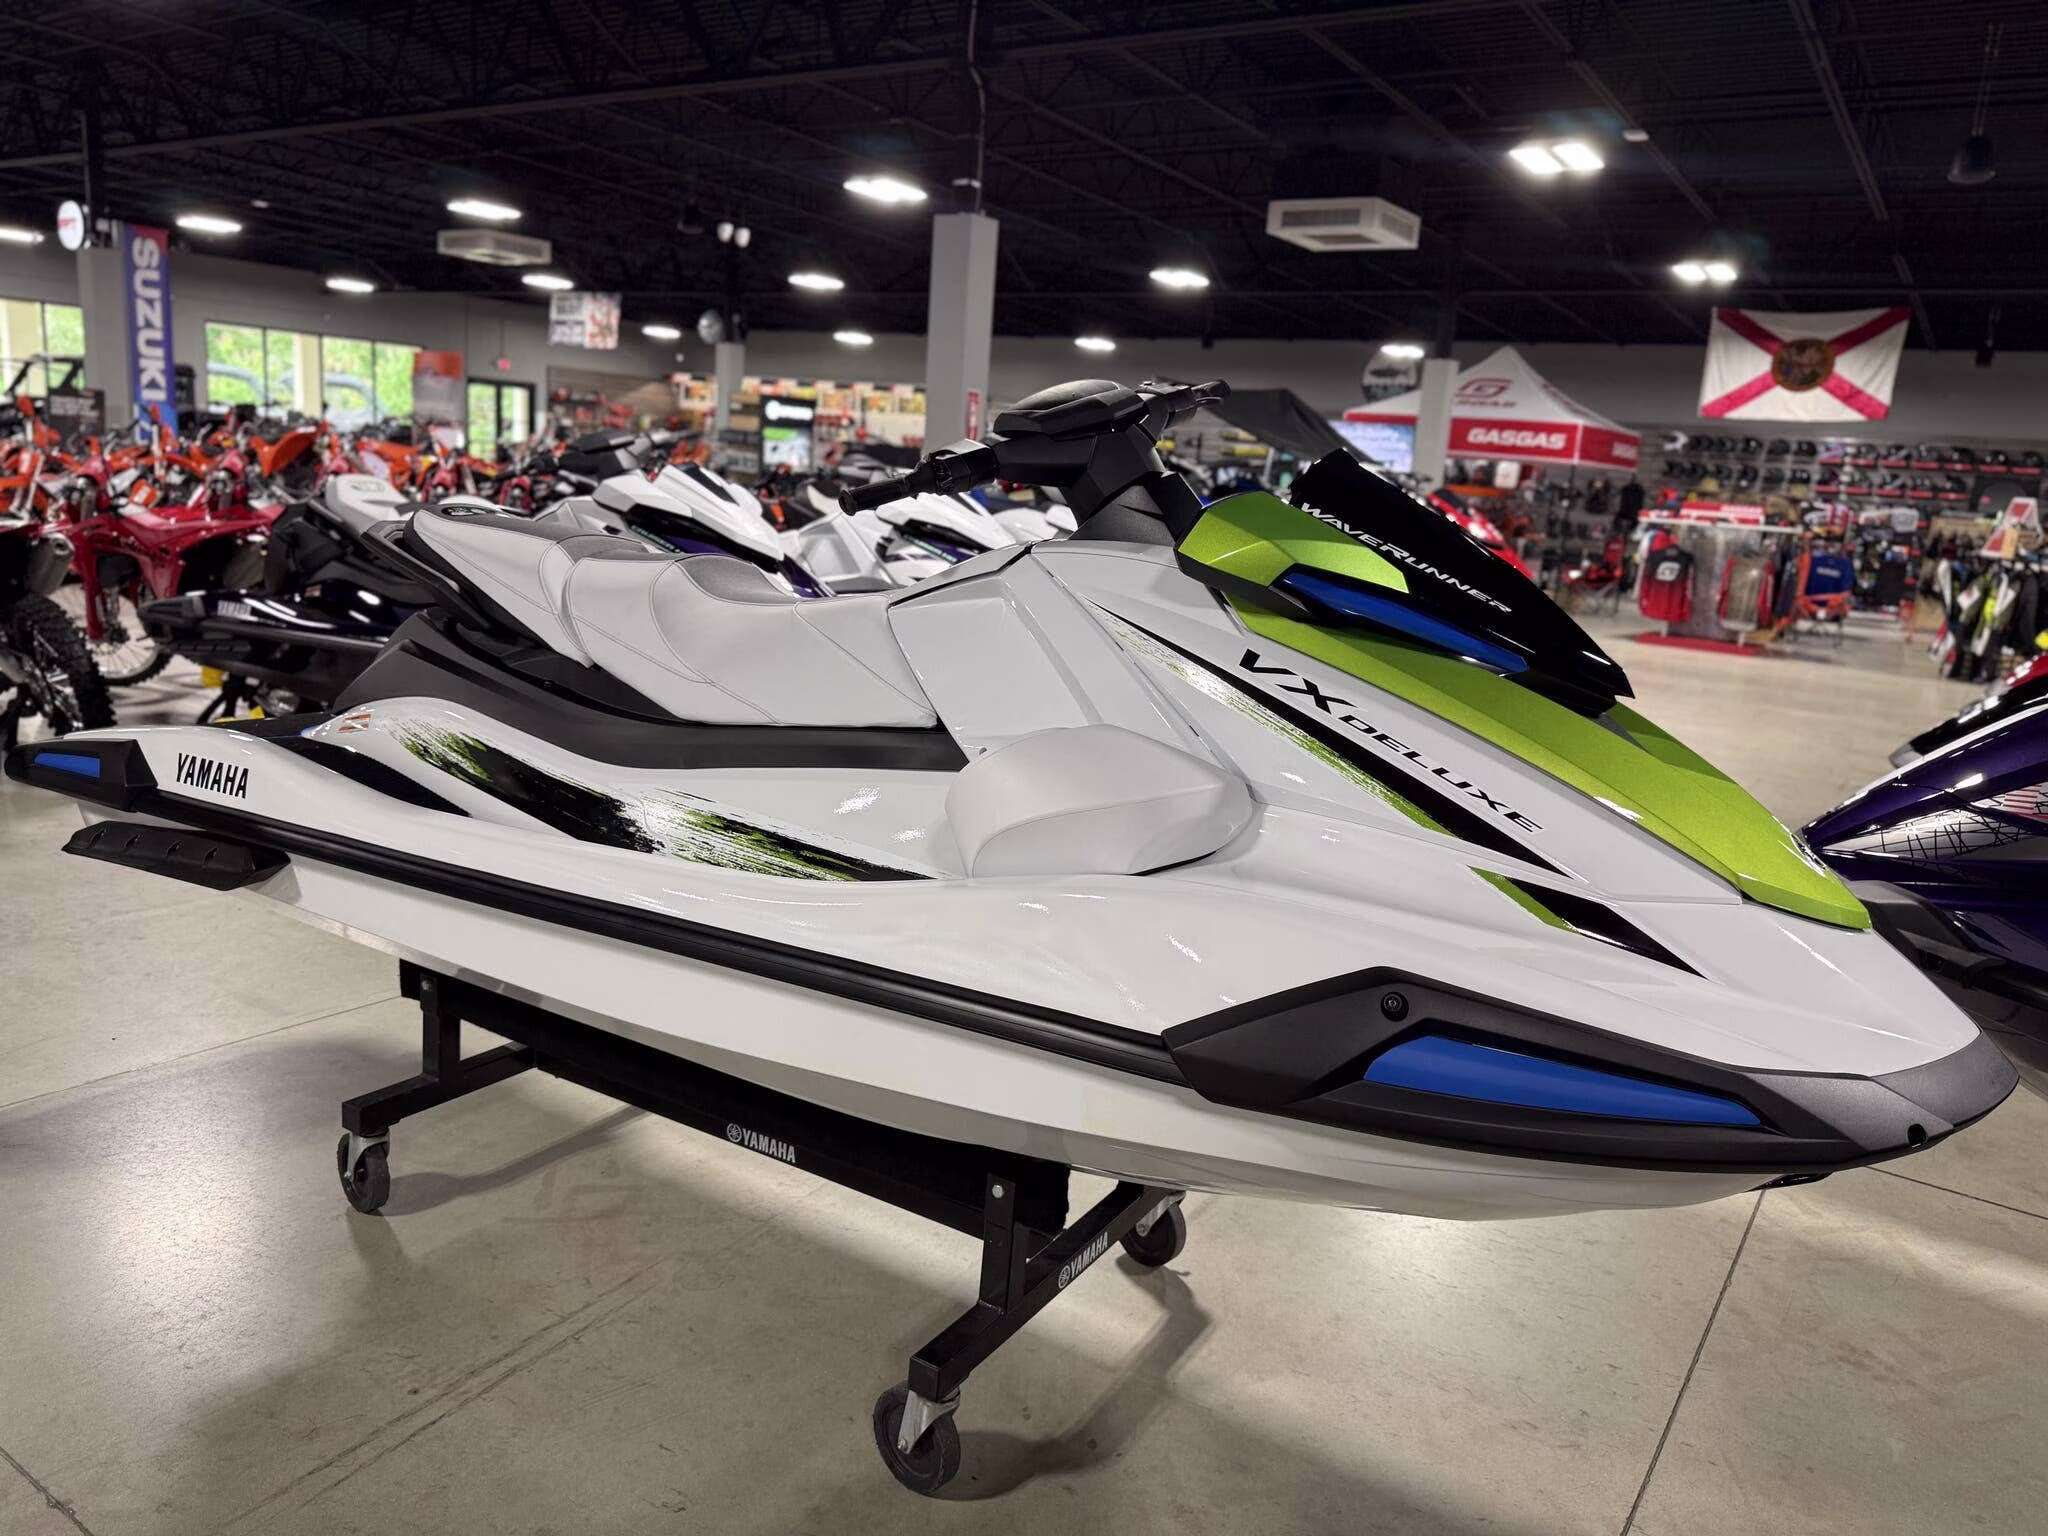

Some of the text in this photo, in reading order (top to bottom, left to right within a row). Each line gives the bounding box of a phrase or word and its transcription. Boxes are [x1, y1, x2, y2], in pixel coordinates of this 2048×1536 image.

[132, 236, 167, 402] SUZUKI
[1466, 426, 1568, 451] GASGAS
[1301, 502, 1513, 614] WAVERUNNER
[1239, 648, 1544, 833] VX DELUXE
[176, 752, 249, 799] YAMAHA
[742, 1128, 796, 1163] YAMAHA
[1071, 1231, 1108, 1279] YAMAHA
